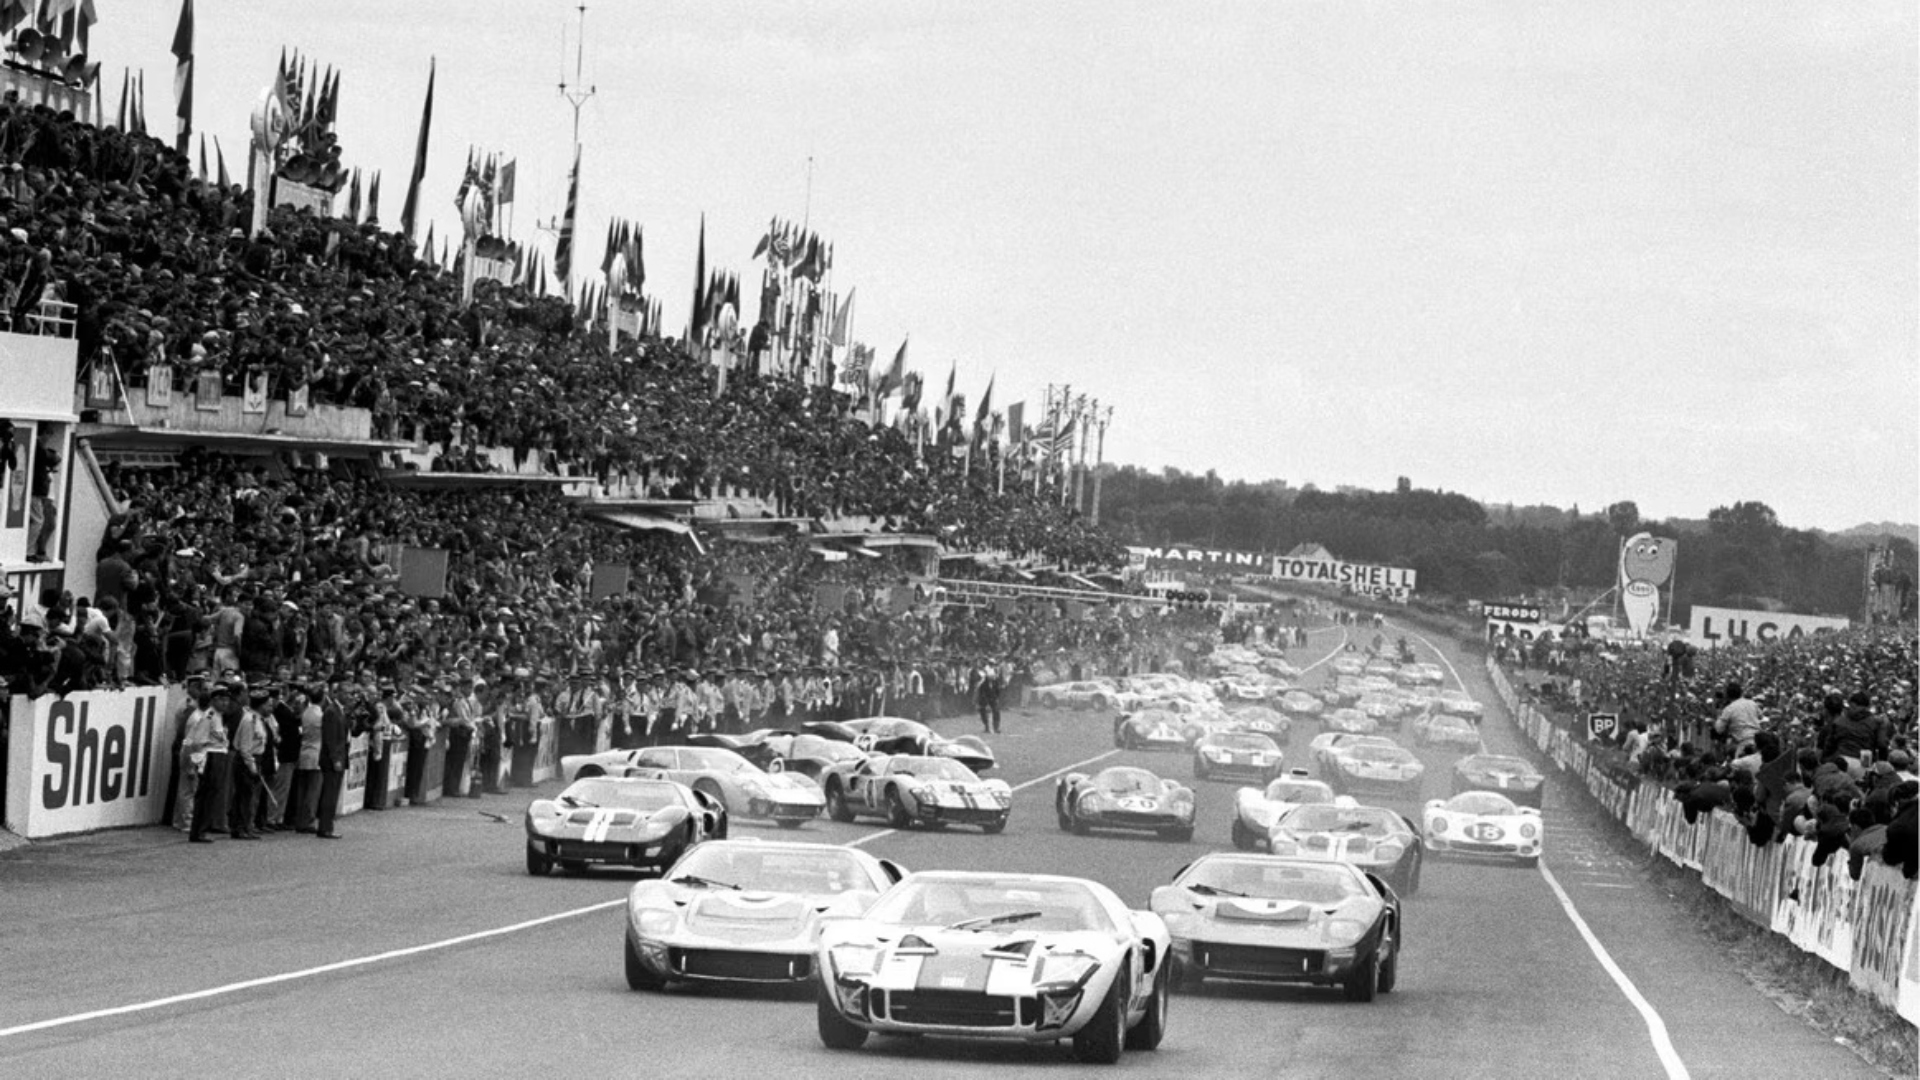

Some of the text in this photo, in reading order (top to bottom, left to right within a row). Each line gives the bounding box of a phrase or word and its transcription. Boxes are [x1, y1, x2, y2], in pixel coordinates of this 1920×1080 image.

[1145, 548, 1262, 566] MARTINI
[1278, 560, 1338, 580] TOTAL
[1340, 565, 1412, 588] SHELL
[1484, 605, 1539, 619] FERODO
[1703, 616, 1834, 645] LUCA
[1595, 719, 1614, 733] BP
[43, 696, 156, 810] Shell
[1473, 824, 1500, 840] 18
